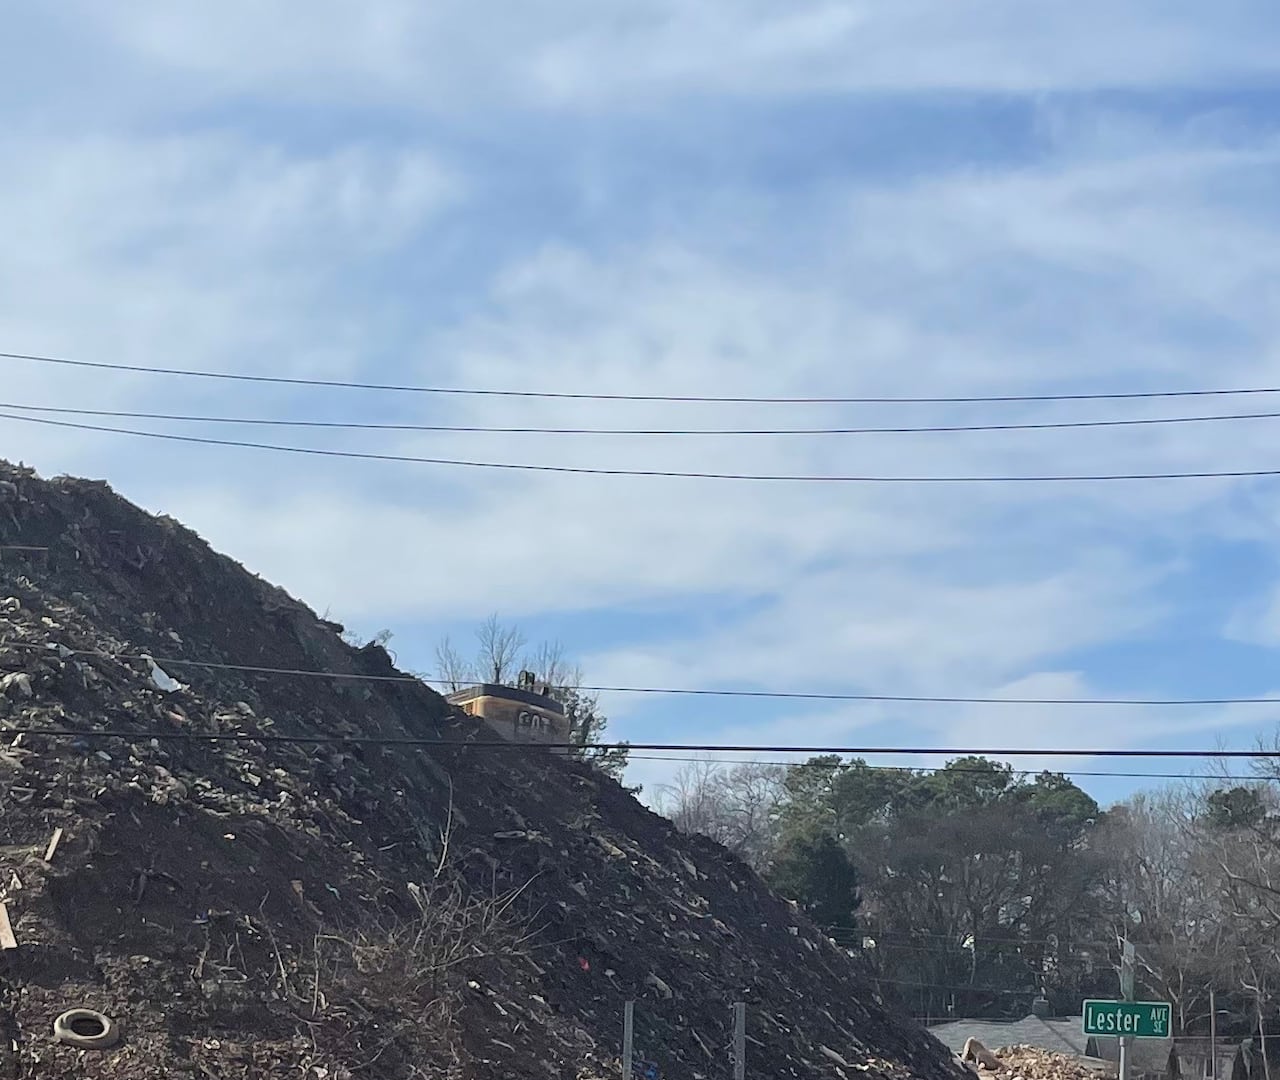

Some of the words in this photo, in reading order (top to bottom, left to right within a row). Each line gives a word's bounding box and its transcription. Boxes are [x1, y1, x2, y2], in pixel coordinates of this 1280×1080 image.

[1087, 1006, 1141, 1032] Lester
[1150, 1007, 1168, 1021] AVE
[1153, 1020, 1164, 1033] SE
